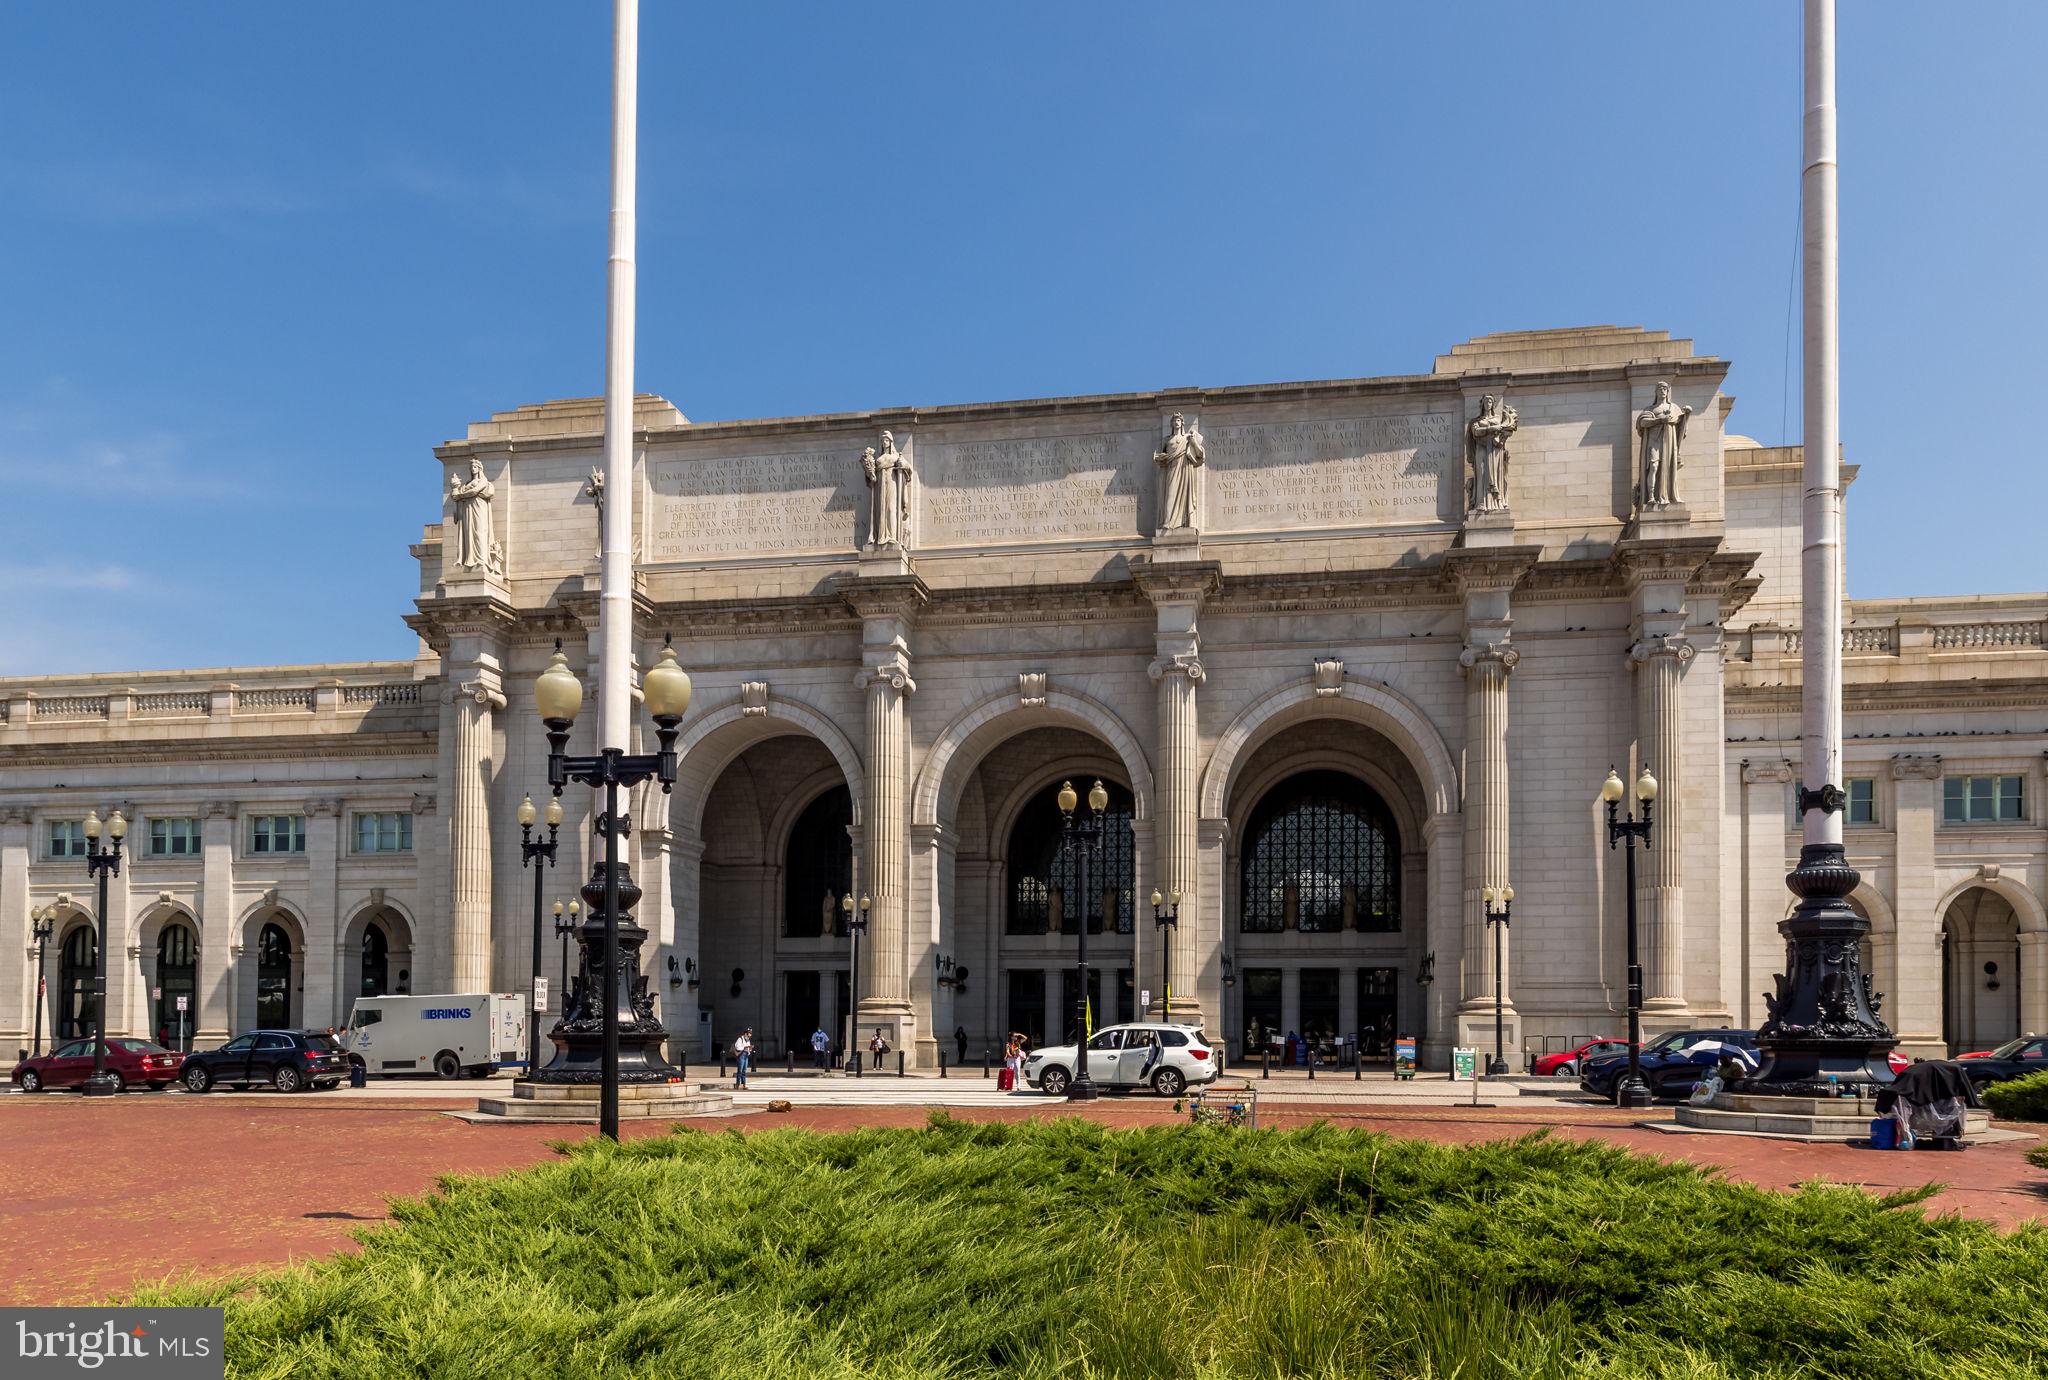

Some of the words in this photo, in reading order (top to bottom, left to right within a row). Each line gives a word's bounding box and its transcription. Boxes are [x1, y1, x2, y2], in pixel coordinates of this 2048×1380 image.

[1426, 451, 1446, 459] NEW
[1222, 471, 1258, 480] FORCES
[1266, 469, 1293, 478] BUILD
[1300, 468, 1318, 476] NEW
[1326, 464, 1374, 474] HIGHWAYS
[1380, 463, 1398, 471] FOR
[1405, 461, 1438, 470] GOODS
[974, 484, 1030, 494] IMAGINATION
[1036, 482, 1054, 490] HAS
[1060, 479, 1112, 490] CONCEIVED
[1120, 478, 1134, 486] ALL
[1216, 482, 1236, 490] AND
[1242, 480, 1262, 488] MEN
[1272, 477, 1319, 487] OVERRIDE
[1326, 475, 1342, 484] THE
[1349, 474, 1382, 483] OCEAN
[1392, 472, 1411, 480] AND
[1223, 490, 1240, 499] THE
[1246, 489, 1270, 498] VERY
[1276, 487, 1306, 496] ETHER
[1312, 485, 1344, 494] CARRY
[1350, 483, 1385, 492] HUMAN
[1392, 480, 1438, 490] THOUGHT
[664, 502, 717, 512] ELECTRICITY
[726, 500, 760, 509] CARRIER
[782, 496, 806, 506] LIGHT
[812, 496, 828, 504] AND
[930, 496, 971, 506] NUMBERS
[979, 495, 996, 503] AND
[1002, 493, 1040, 502] LETTERS
[1051, 491, 1067, 500] ALL
[1072, 488, 1100, 498] TOOLS
[933, 506, 950, 515] AND
[956, 504, 1000, 514] SHELTERS
[1010, 502, 1037, 510] EVERY
[1043, 500, 1058, 509] ART
[1064, 499, 1082, 508] AND
[1090, 497, 1118, 506] TRADE
[1222, 506, 1239, 514] THE
[1244, 504, 1281, 514] DESERT
[1287, 502, 1317, 512] SHALL
[1323, 500, 1362, 510] REJOICE
[1368, 498, 1388, 507] AND
[1393, 496, 1438, 506] BLOSSOM
[670, 522, 681, 530] OF
[686, 520, 717, 529] HUMAN
[722, 518, 754, 527] SPEECH
[759, 516, 780, 525] OVER
[786, 515, 810, 524] LAND
[816, 514, 834, 522] AND
[839, 512, 856, 520] SEA
[672, 511, 716, 520] DEVOURER
[722, 510, 731, 518] OF
[737, 509, 756, 518] TIME
[762, 508, 779, 516] AND
[785, 506, 810, 514] SPACE
[934, 514, 986, 524] PHILOSOPHY
[992, 512, 1010, 520] AND
[1017, 510, 1048, 520] POETRY
[1058, 509, 1076, 517] AND
[1082, 508, 1097, 516] ALL
[1103, 505, 1142, 514] POLITIES
[1296, 512, 1307, 520] AS
[1316, 511, 1332, 520] THE
[1338, 510, 1363, 518] ROSE
[658, 530, 700, 540] GREATEST
[705, 527, 742, 537] SERVANT
[748, 526, 757, 534] OF
[792, 523, 818, 532] ITSELF
[824, 520, 867, 530] UNKNOWN
[955, 530, 971, 538] THE
[976, 528, 1004, 537] TRUTH
[1010, 526, 1038, 536] SHALL
[1043, 524, 1068, 532] MAKE
[1074, 522, 1091, 530] YOU
[1098, 522, 1120, 530] FREE
[662, 546, 682, 554] THOU
[688, 544, 710, 552] HAST
[714, 542, 730, 552] PUT
[736, 542, 749, 550] ALL
[755, 540, 785, 549] THINGS
[790, 538, 819, 547] UNDER
[825, 536, 838, 545] HIS
[430, 1008, 471, 1019] BRINKS
